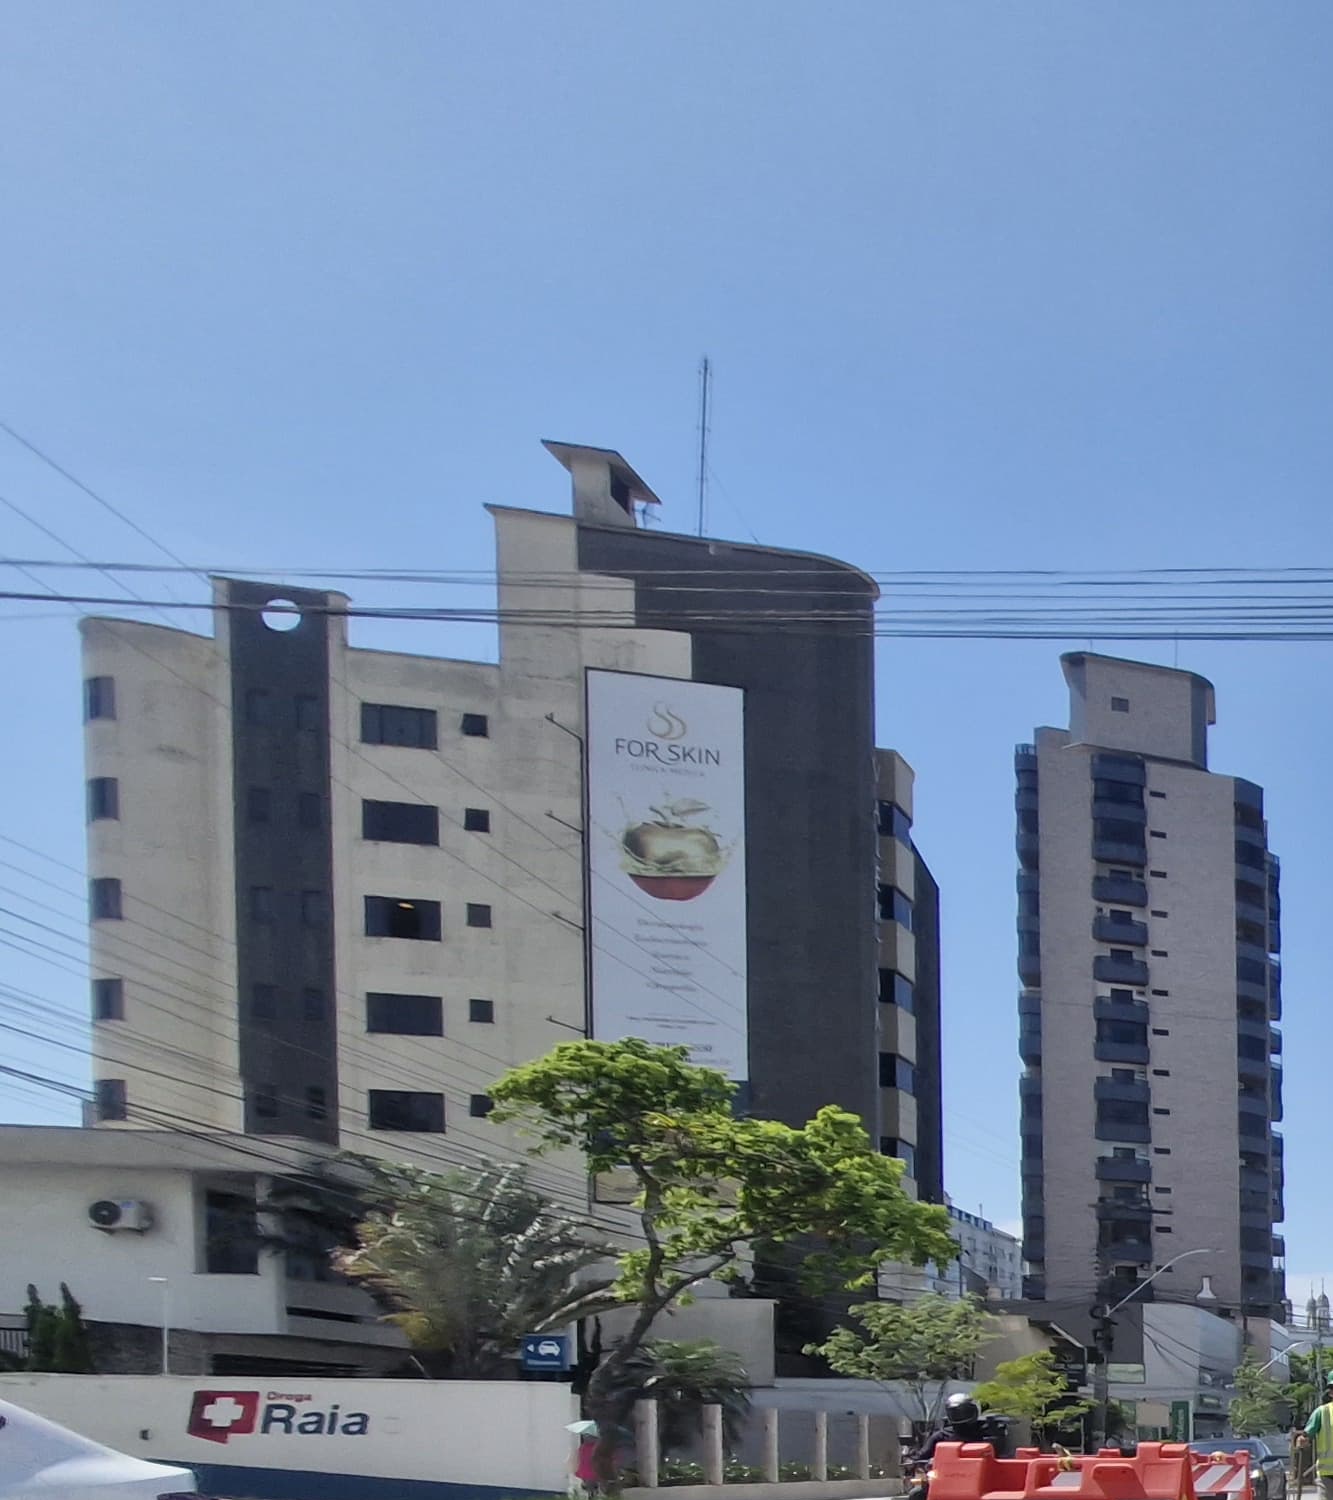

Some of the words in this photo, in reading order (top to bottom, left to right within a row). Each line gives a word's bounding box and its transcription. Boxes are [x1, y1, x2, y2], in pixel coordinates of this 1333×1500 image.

[615, 738, 669, 763] FOR
[667, 744, 720, 766] SKIN
[267, 1391, 312, 1402] Droga
[260, 1404, 370, 1435] Raia
